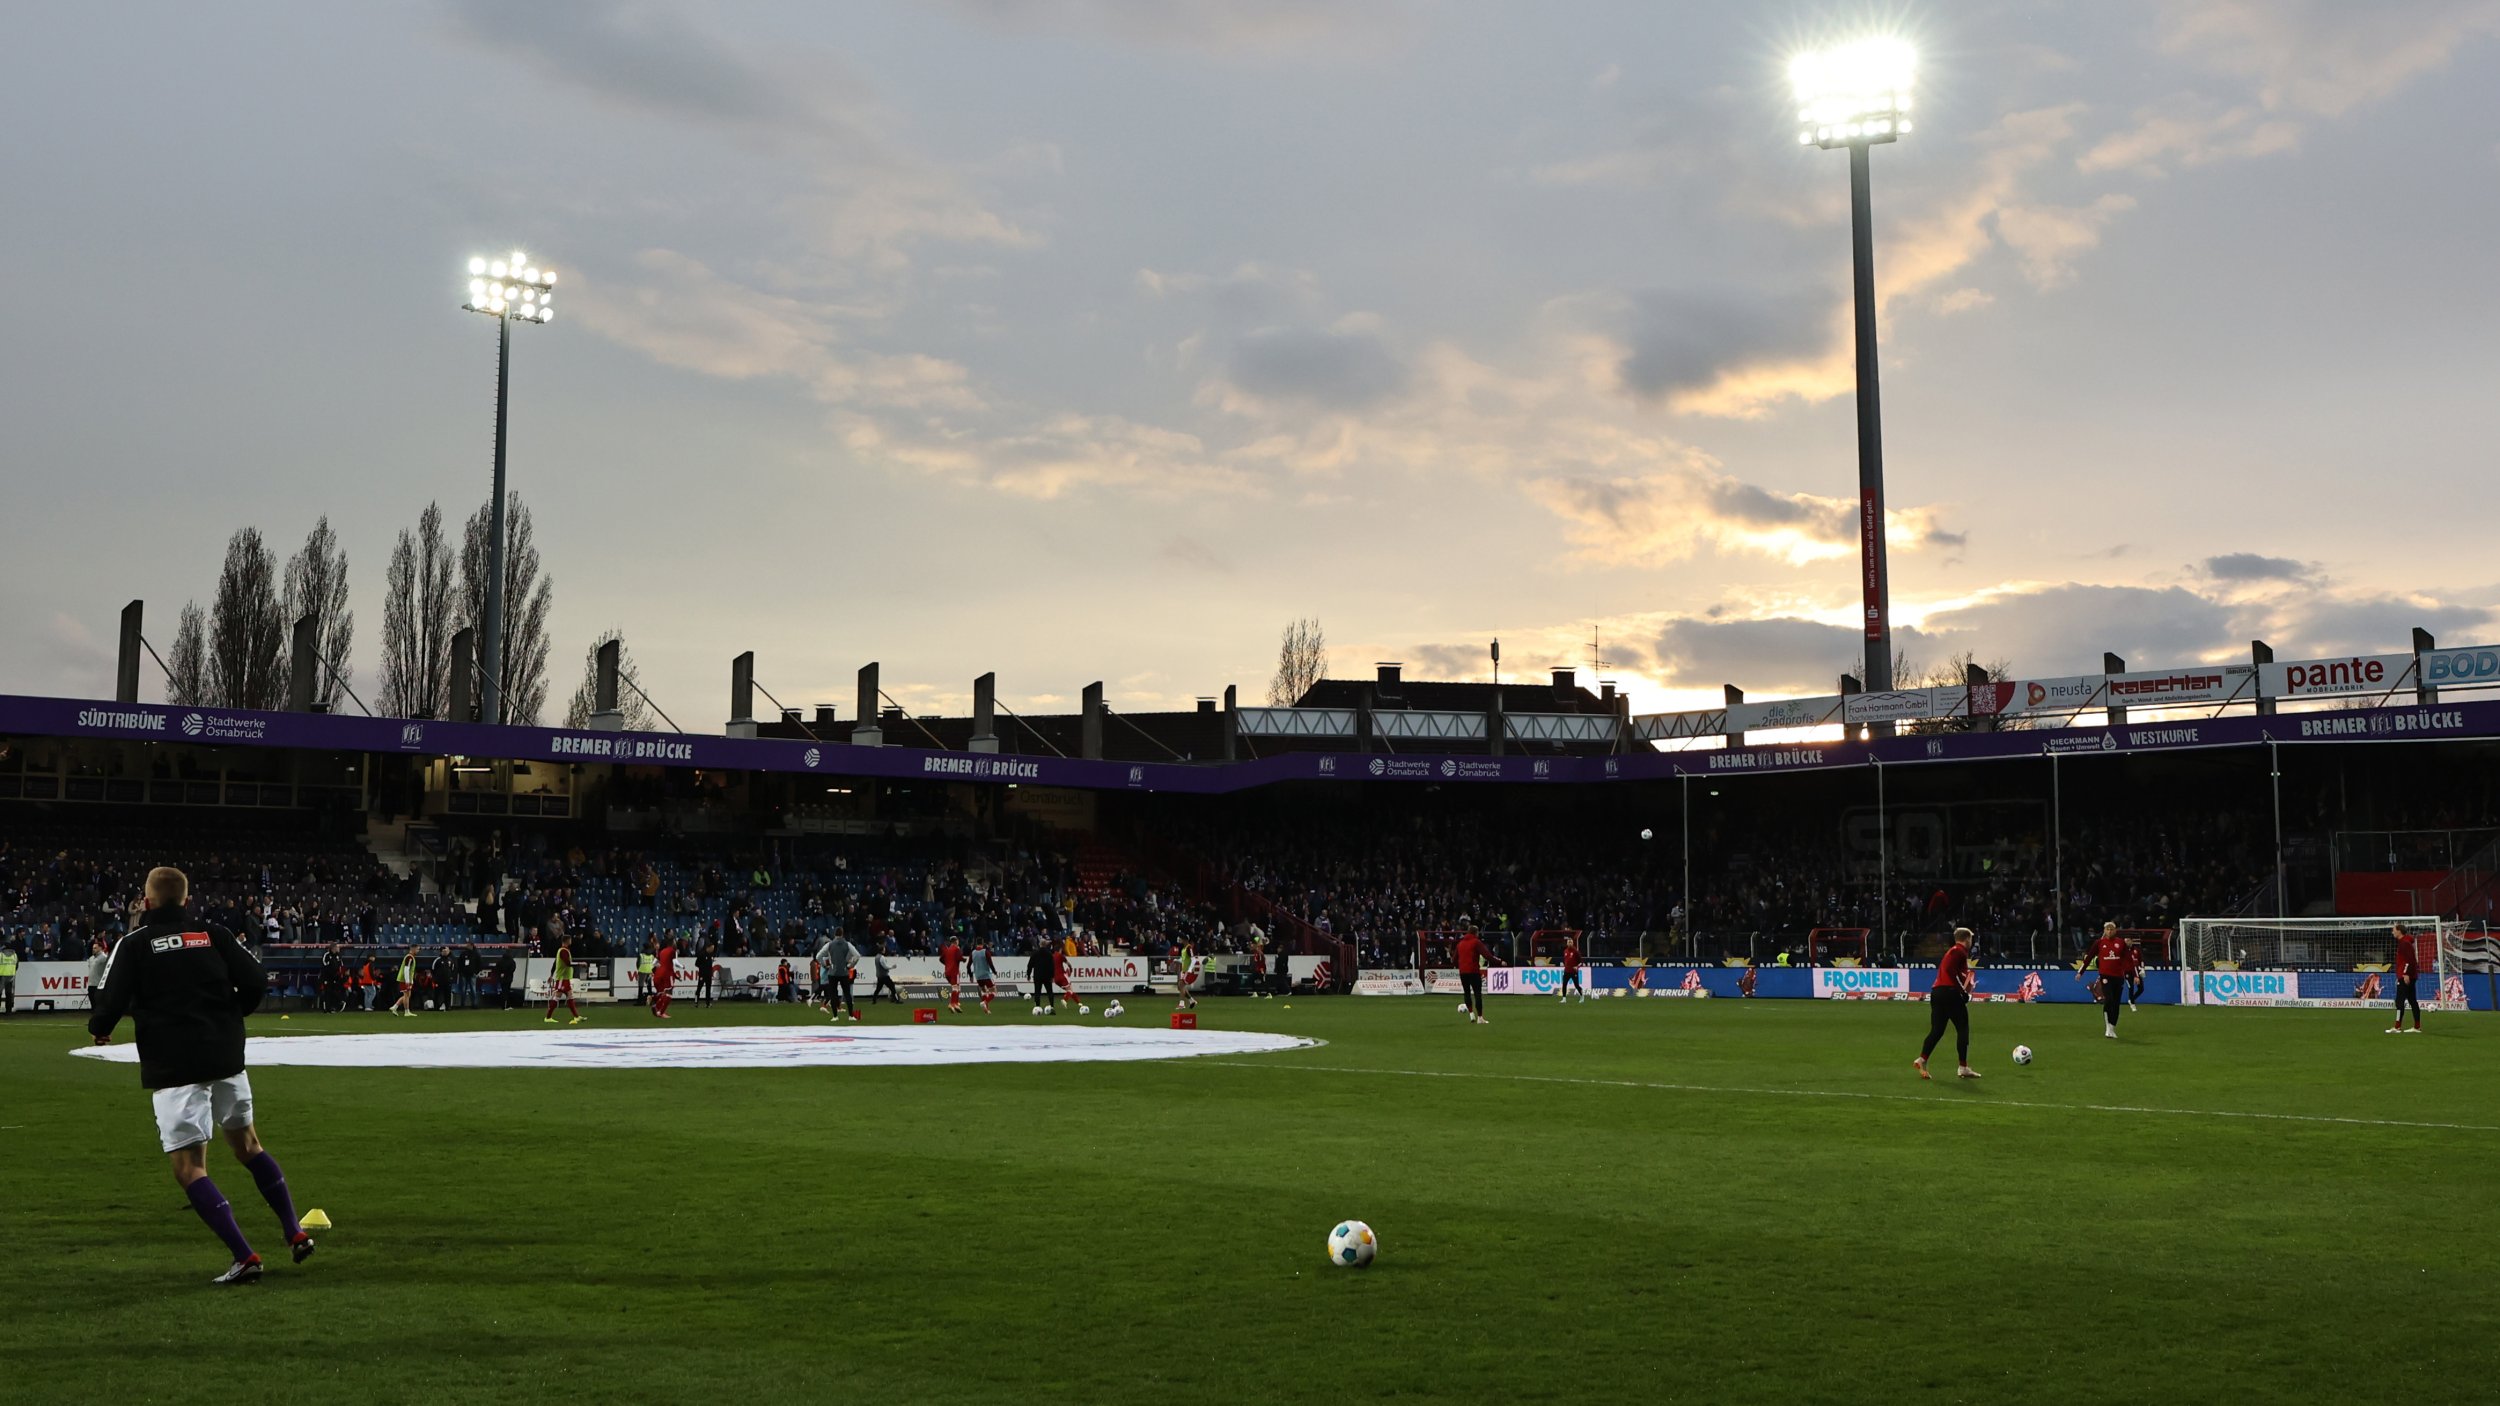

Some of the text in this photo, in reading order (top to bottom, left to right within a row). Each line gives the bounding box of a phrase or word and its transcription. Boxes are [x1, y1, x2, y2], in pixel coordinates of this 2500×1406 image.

[2429, 652, 2500, 679] BOD
[2286, 657, 2384, 694] pante
[2051, 678, 2092, 696] neusta
[1769, 706, 1784, 717] die
[1848, 705, 1867, 713] Frank
[1869, 702, 1904, 712] Hartmann
[1905, 700, 1928, 709] GmbH
[78, 708, 166, 730] SÜDTRIBÜNE
[207, 716, 266, 729] Stadtwerke
[1761, 713, 1815, 727] 2radprofis
[2301, 717, 2367, 736] BREMER
[2395, 709, 2464, 731] BRÜCKE
[206, 726, 264, 739] Osnabrück
[2129, 728, 2199, 746] WESTKURVE
[551, 736, 611, 755] BREMER
[635, 739, 692, 759] BRÜCKE
[2050, 736, 2100, 745] DIECKMANN
[1387, 760, 1430, 768] Stadtwerke
[1458, 761, 1501, 769] Stadtwerke
[1709, 754, 1756, 769] BREMER
[1775, 748, 1824, 765] BRÜCKE
[924, 757, 973, 774] BREMER
[992, 759, 1039, 778] BRÜCKE
[1386, 767, 1430, 776] Osnabrück
[1458, 768, 1501, 777] Osnabrück
[153, 936, 208, 951] SO TECH
[1823, 971, 1898, 991] FRONERI
[1653, 988, 1690, 997] MERKUR
[2274, 999, 2314, 1007] BÜROMÖBEL
